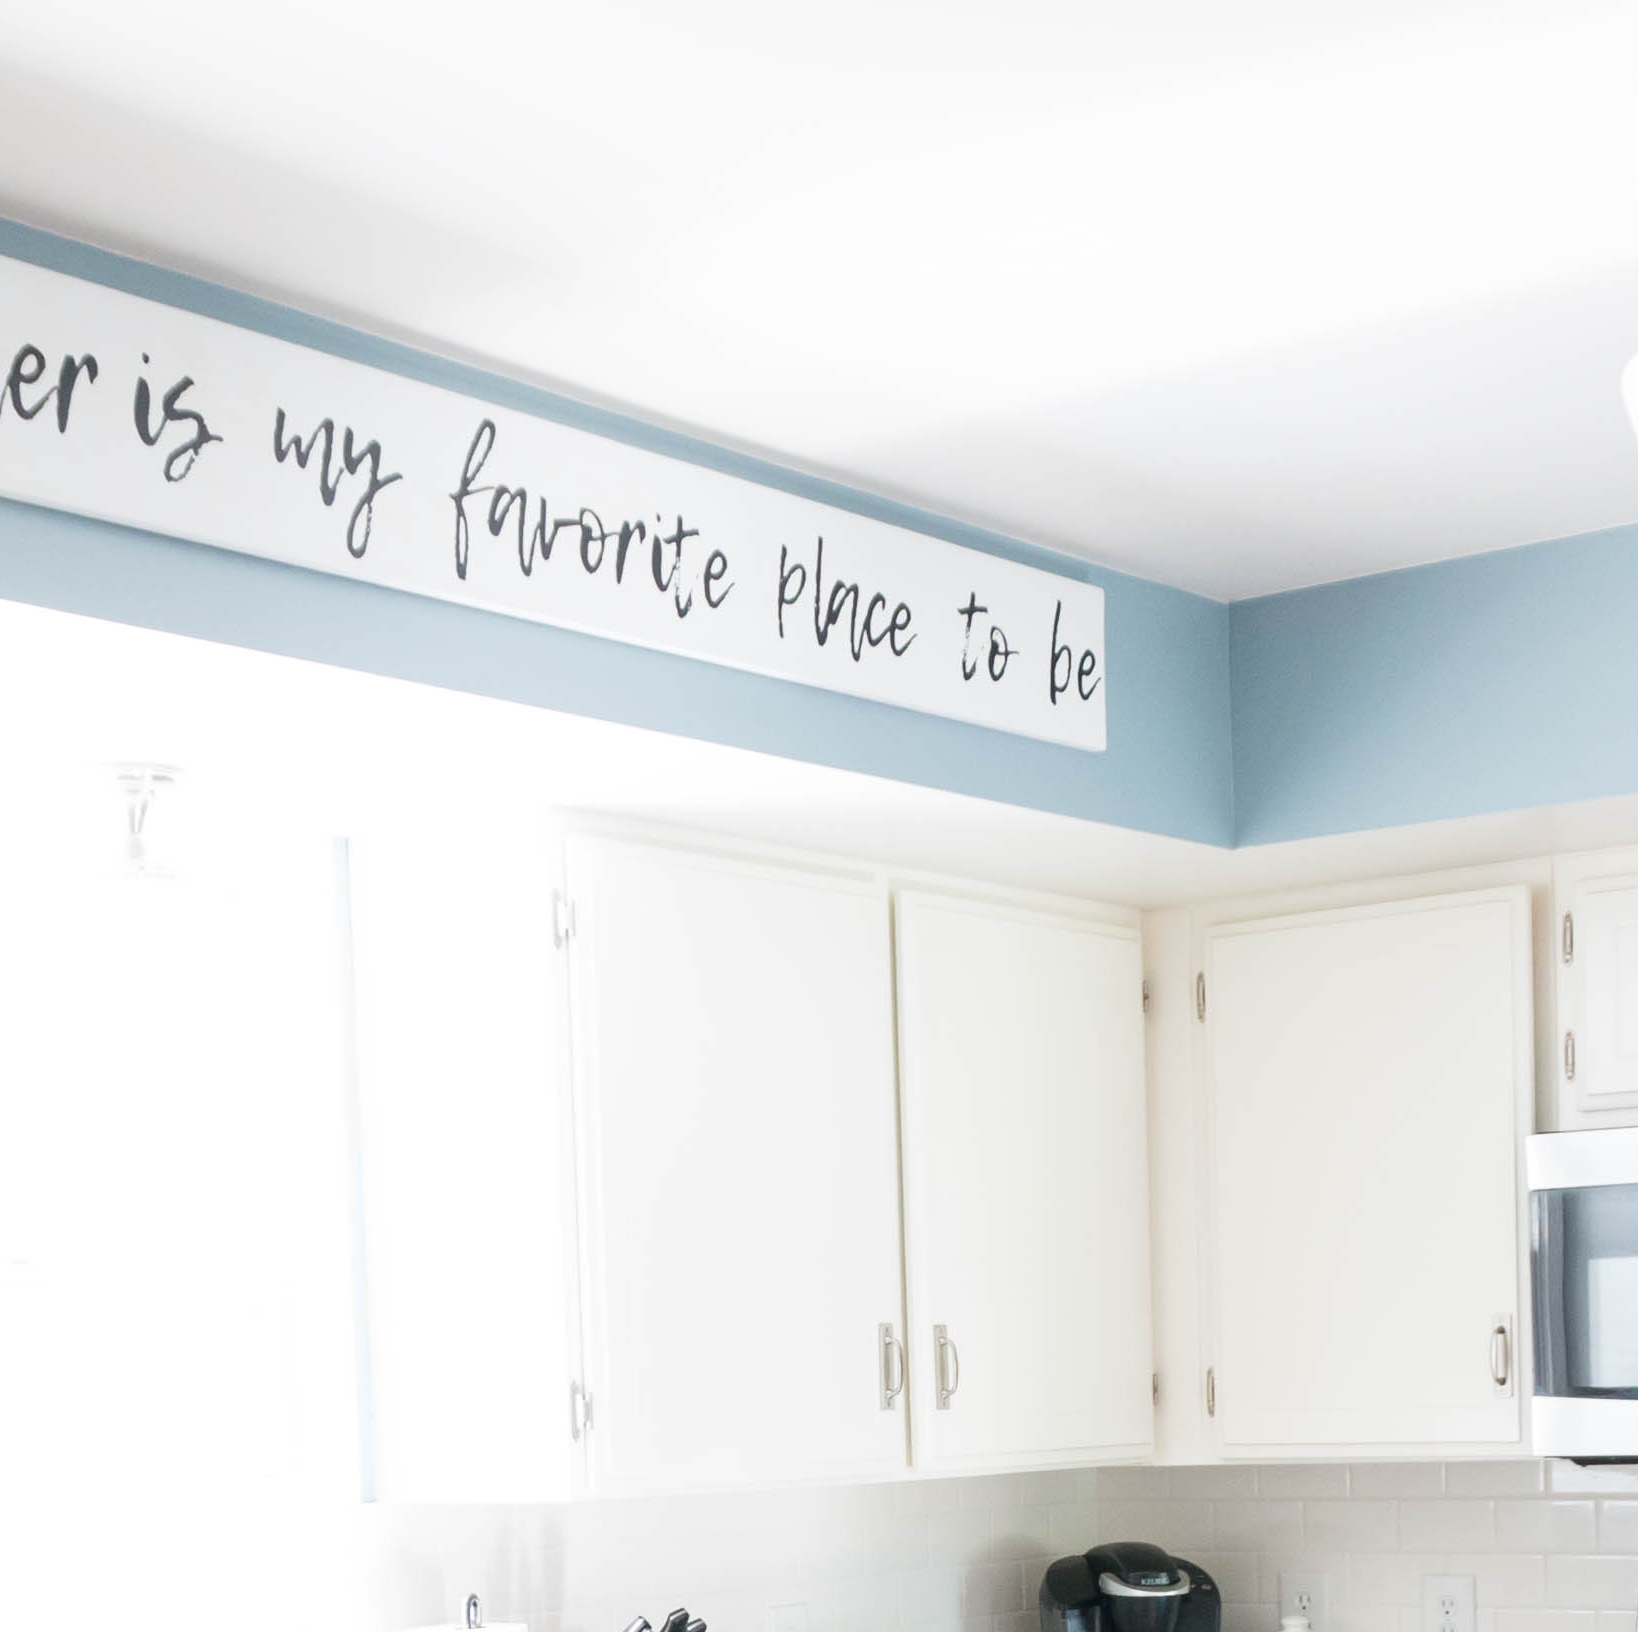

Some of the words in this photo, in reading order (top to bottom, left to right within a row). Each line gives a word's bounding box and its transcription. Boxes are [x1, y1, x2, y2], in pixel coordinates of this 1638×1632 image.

[134, 352, 223, 482] is
[273, 405, 403, 559] my
[449, 418, 735, 618] favorite
[777, 536, 918, 662] place
[957, 591, 1020, 681] to
[1050, 598, 1102, 706] be
